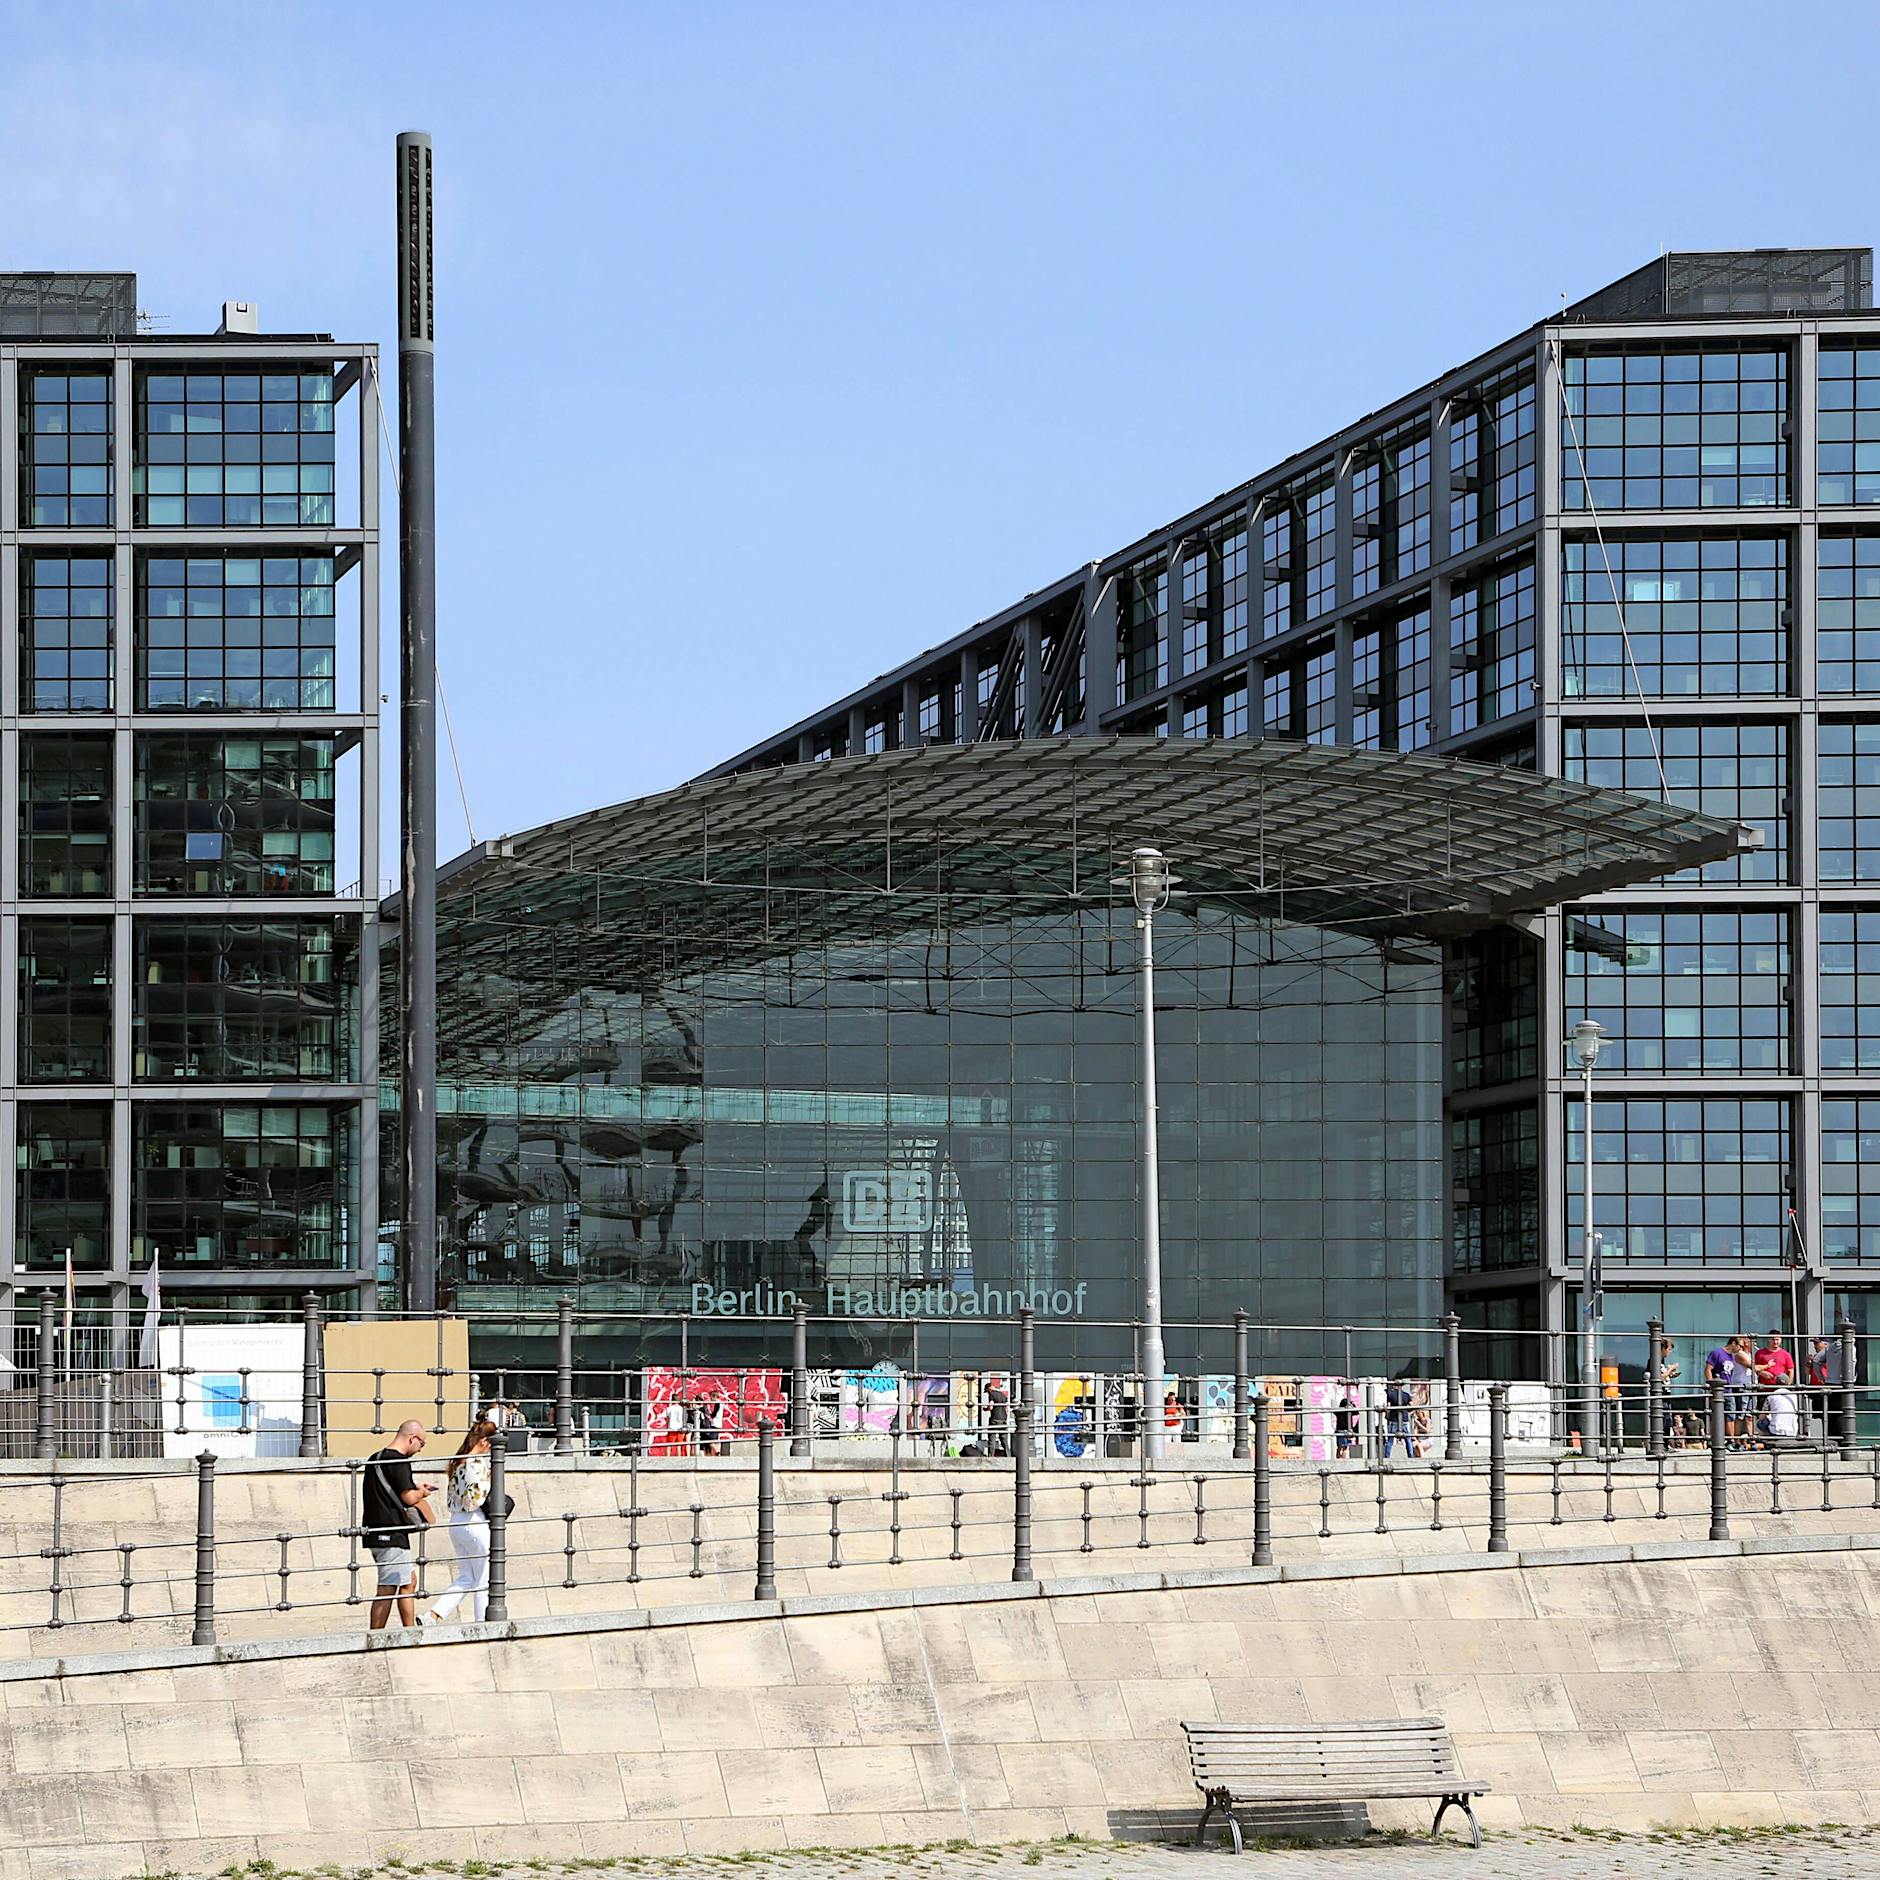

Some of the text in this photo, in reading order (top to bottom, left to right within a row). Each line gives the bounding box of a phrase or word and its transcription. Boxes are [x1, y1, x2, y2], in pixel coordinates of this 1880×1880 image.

[854, 1179, 924, 1222] DB
[691, 1282, 1087, 1318] Berlin Hauptbahnhof
